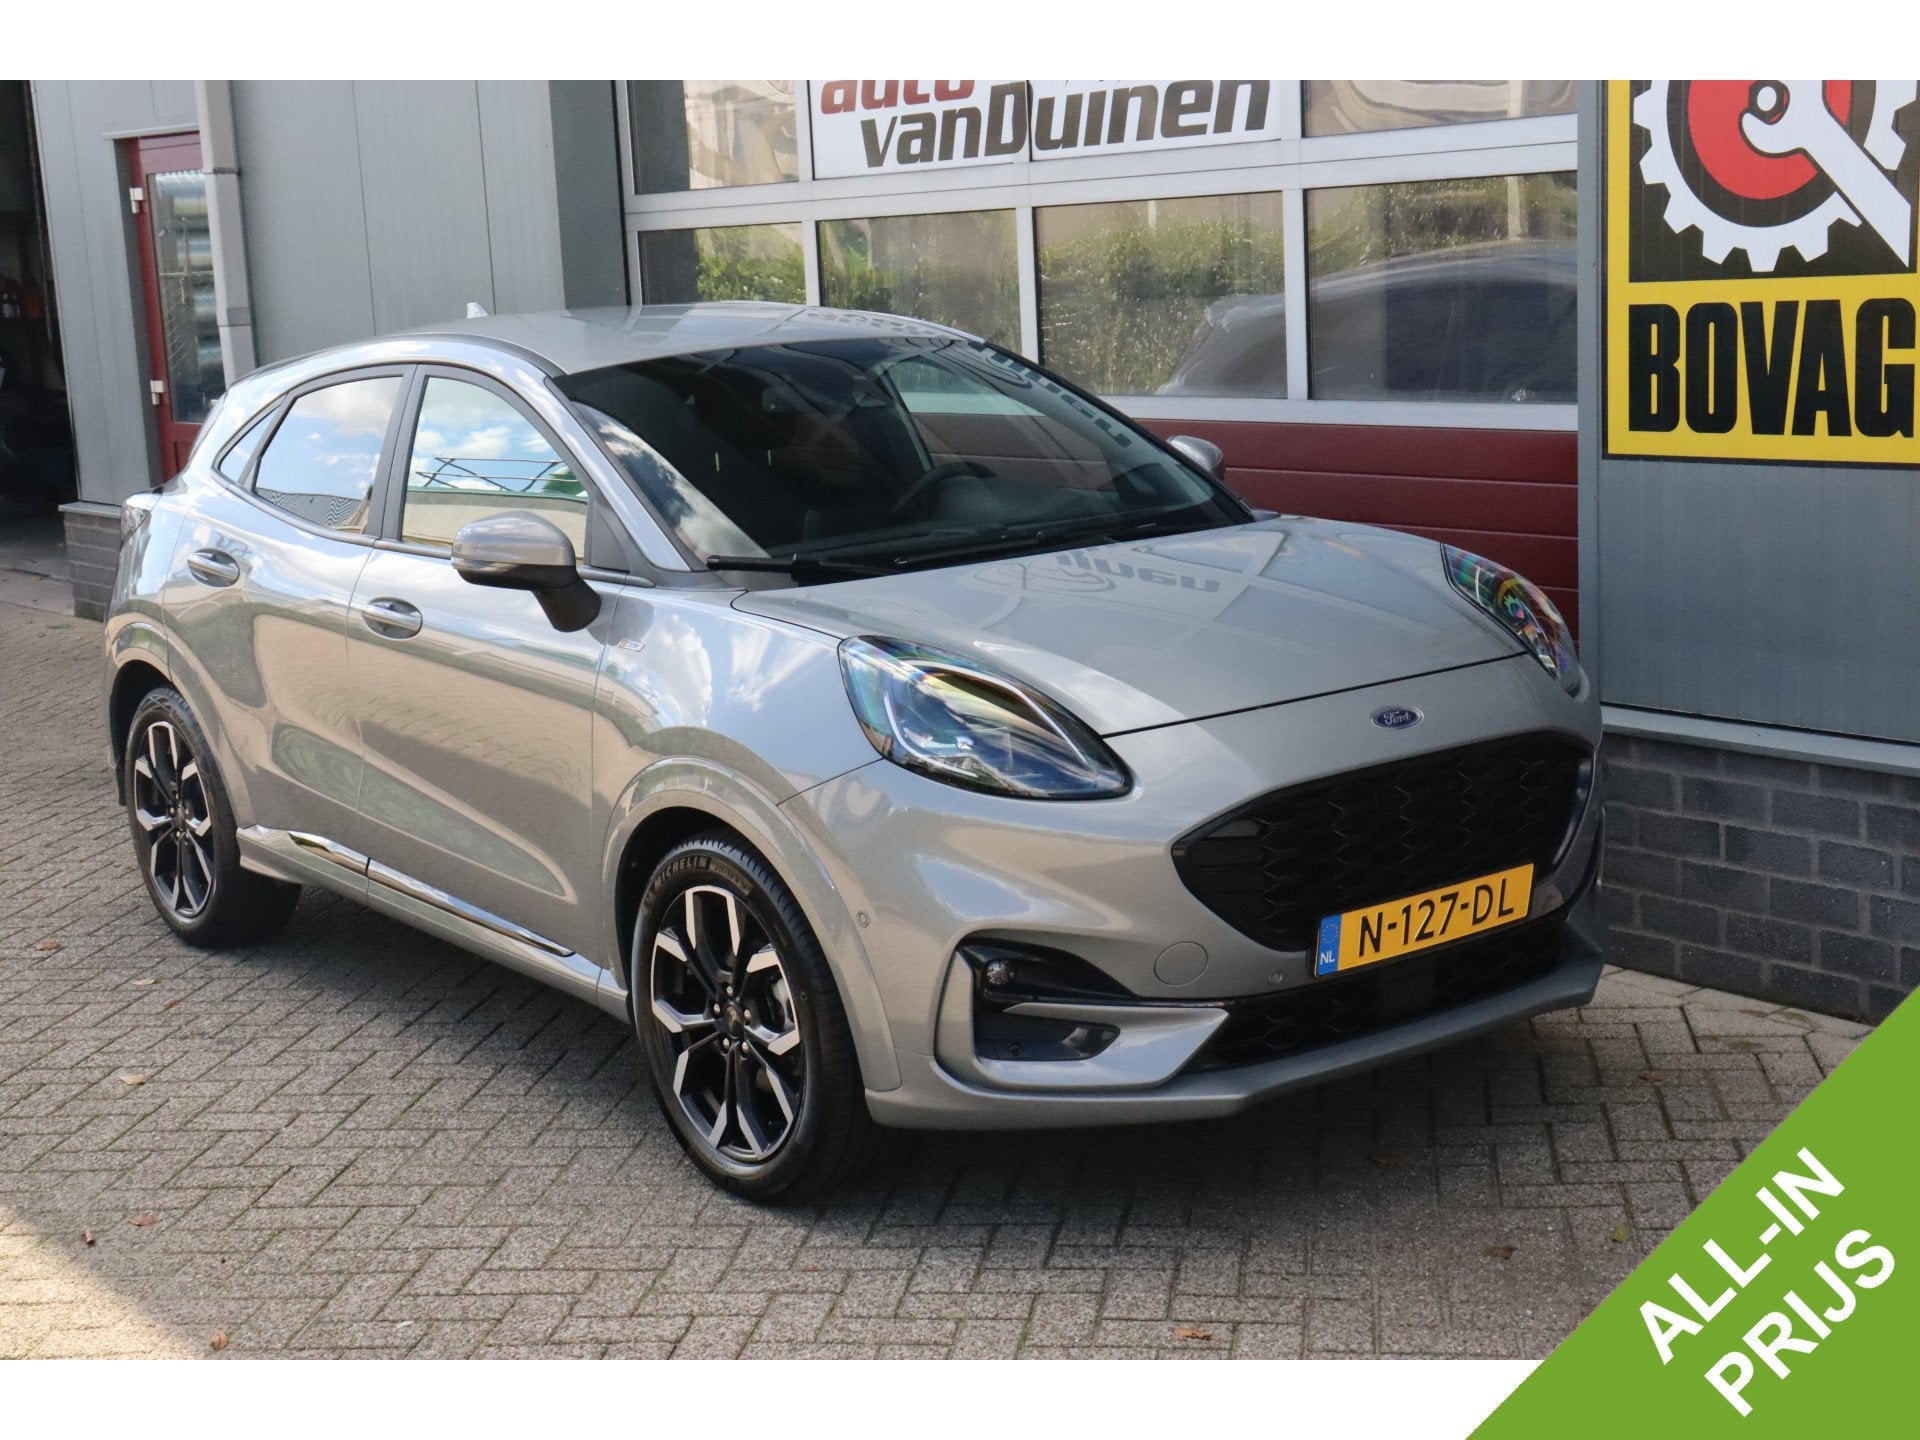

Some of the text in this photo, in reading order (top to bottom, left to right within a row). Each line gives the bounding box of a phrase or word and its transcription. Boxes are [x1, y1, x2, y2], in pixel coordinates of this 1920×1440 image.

[1627, 298, 1917, 438] BOVAG
[1382, 710, 1410, 726] Ford
[654, 856, 709, 890] MICHELIN
[1358, 878, 1514, 957] N-127-DL
[1320, 951, 1335, 965] NL
